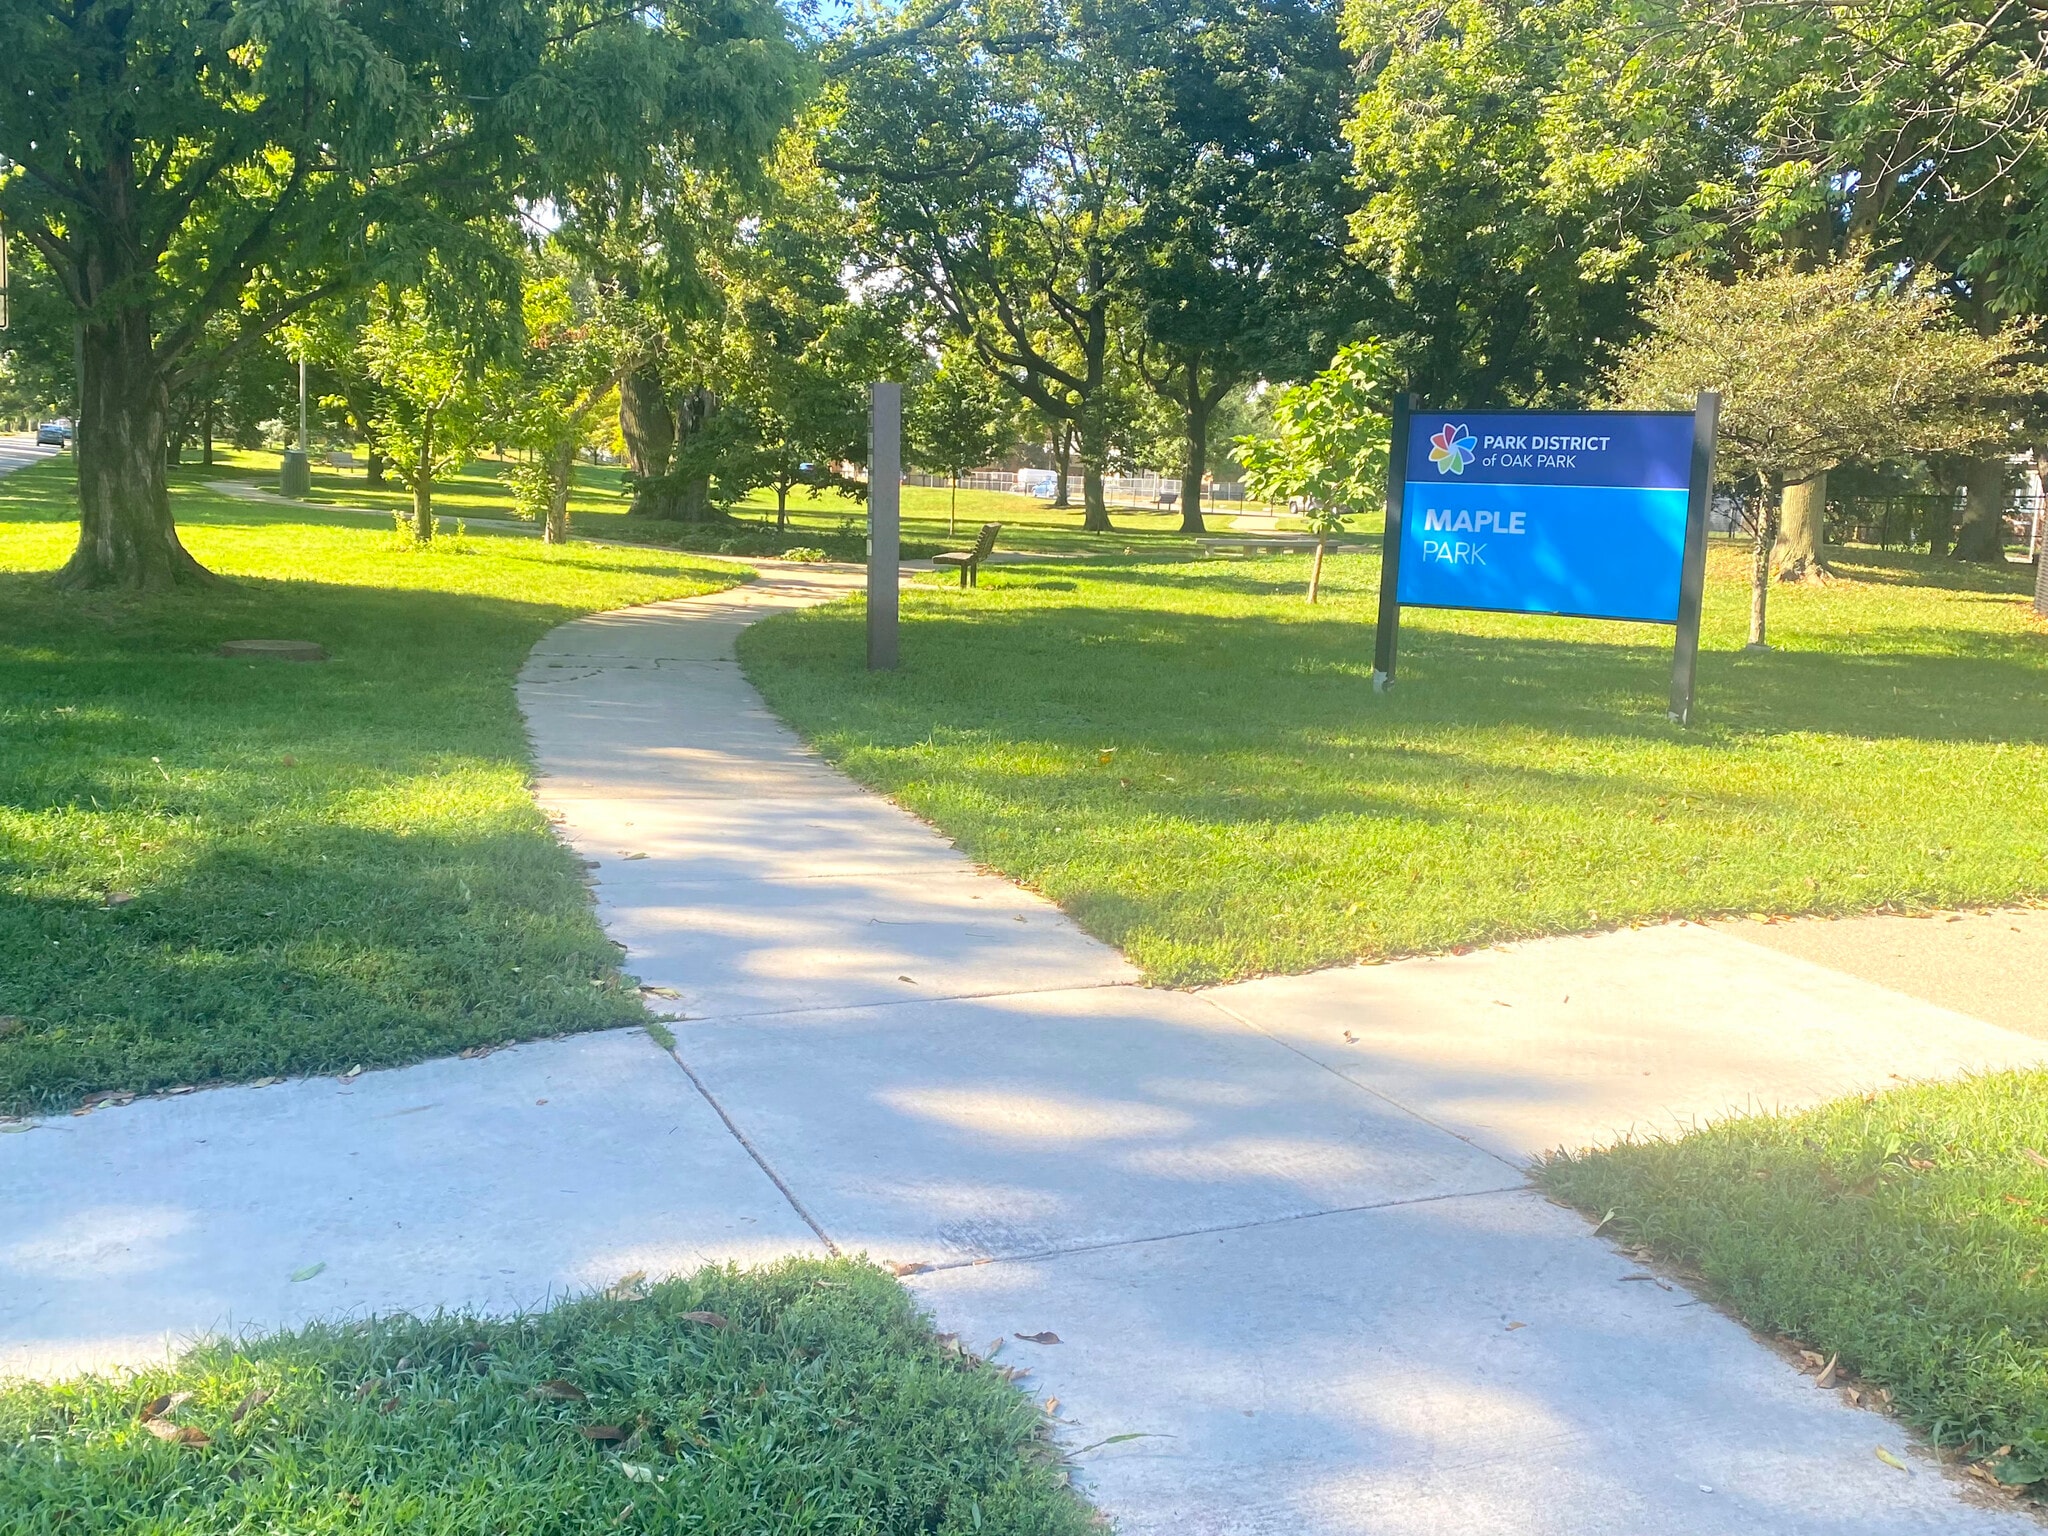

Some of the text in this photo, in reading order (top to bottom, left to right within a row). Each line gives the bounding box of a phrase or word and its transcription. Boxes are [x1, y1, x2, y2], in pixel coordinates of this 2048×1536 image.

[1483, 435, 1610, 451] PARK DISTRICT
[1482, 453, 1576, 469] of OAK PARK
[1424, 508, 1526, 534] MAPLE
[1422, 540, 1488, 565] PARK
